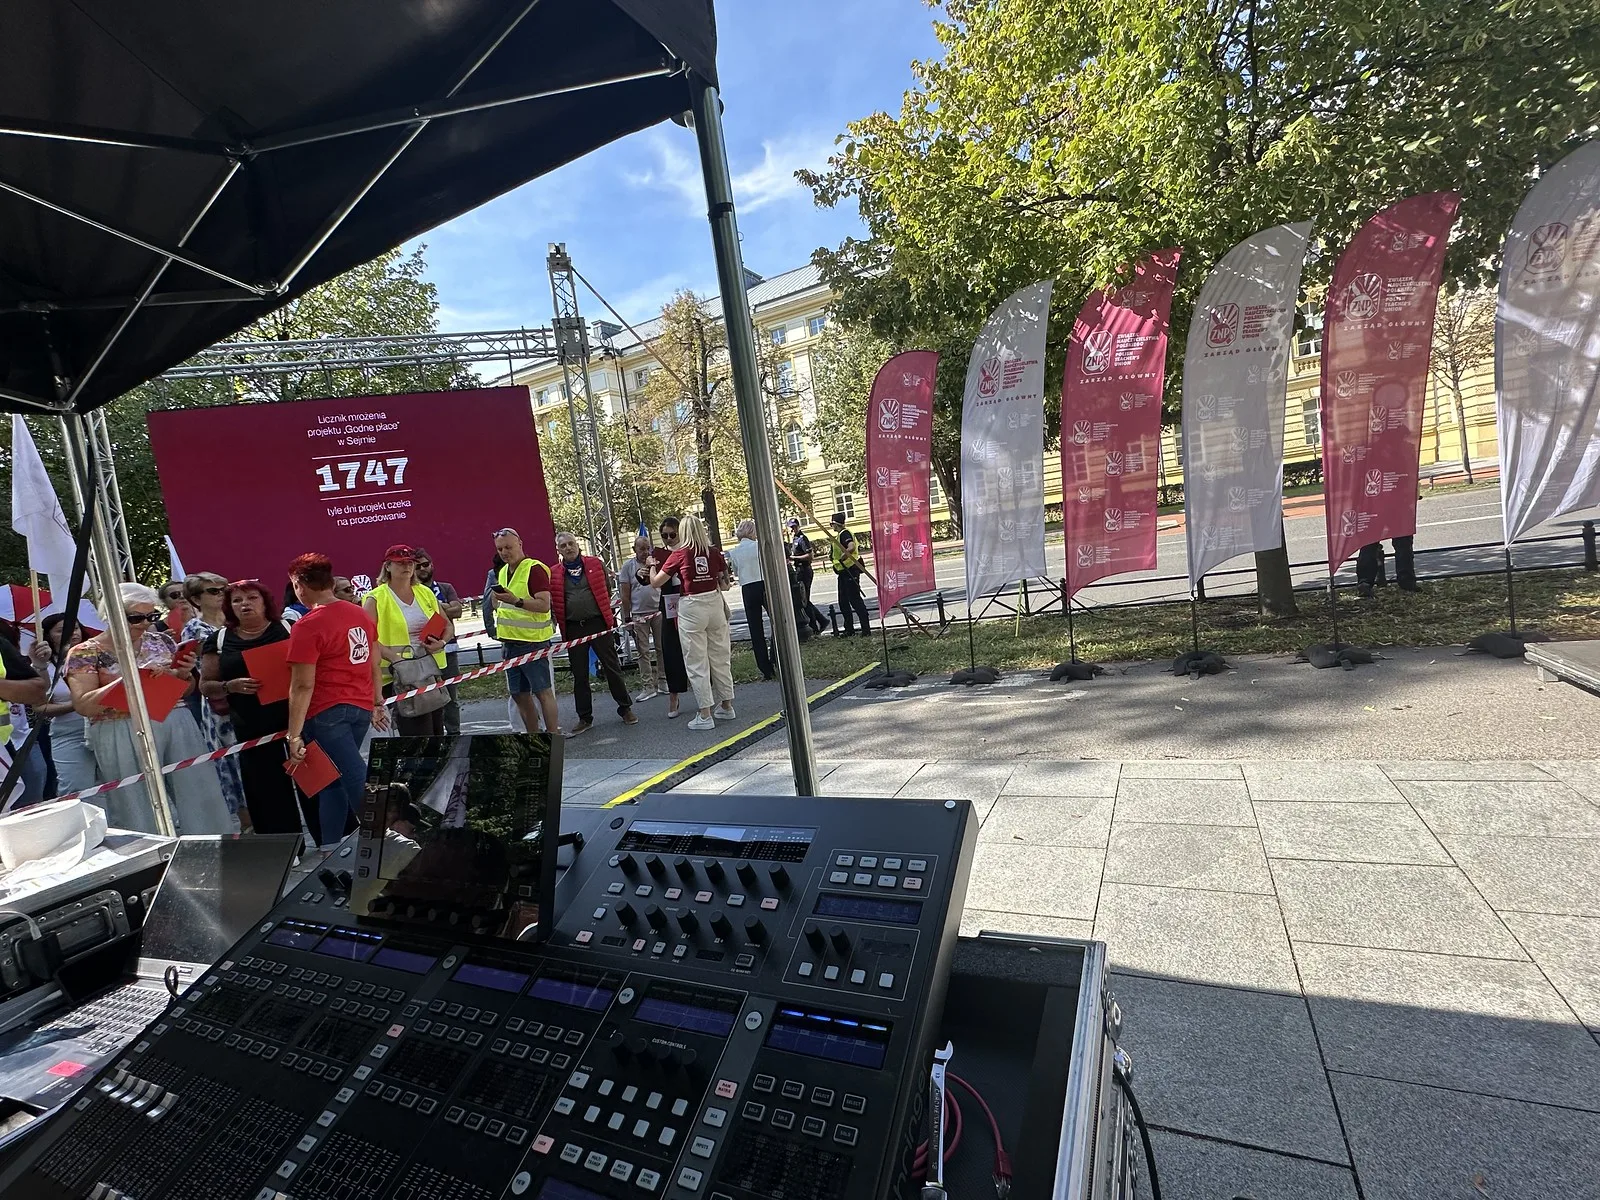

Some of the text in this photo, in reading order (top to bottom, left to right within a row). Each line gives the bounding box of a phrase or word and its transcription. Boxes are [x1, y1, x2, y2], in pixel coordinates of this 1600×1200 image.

[1351, 300, 1371, 312] ZNP
[1344, 323, 1382, 331] ZARZĄD
[1212, 328, 1230, 340] ZNP
[1086, 355, 1104, 367] ZNP
[1080, 372, 1157, 384] ZARZĄD GŁÓWNY
[318, 411, 387, 424] Licznik mrożenia
[307, 426, 342, 439] projektu
[337, 435, 376, 446] w Sejmie
[316, 457, 409, 492] 1747
[327, 500, 412, 517] tyle dni projekt czeka
[337, 511, 407, 527] na procedowanie
